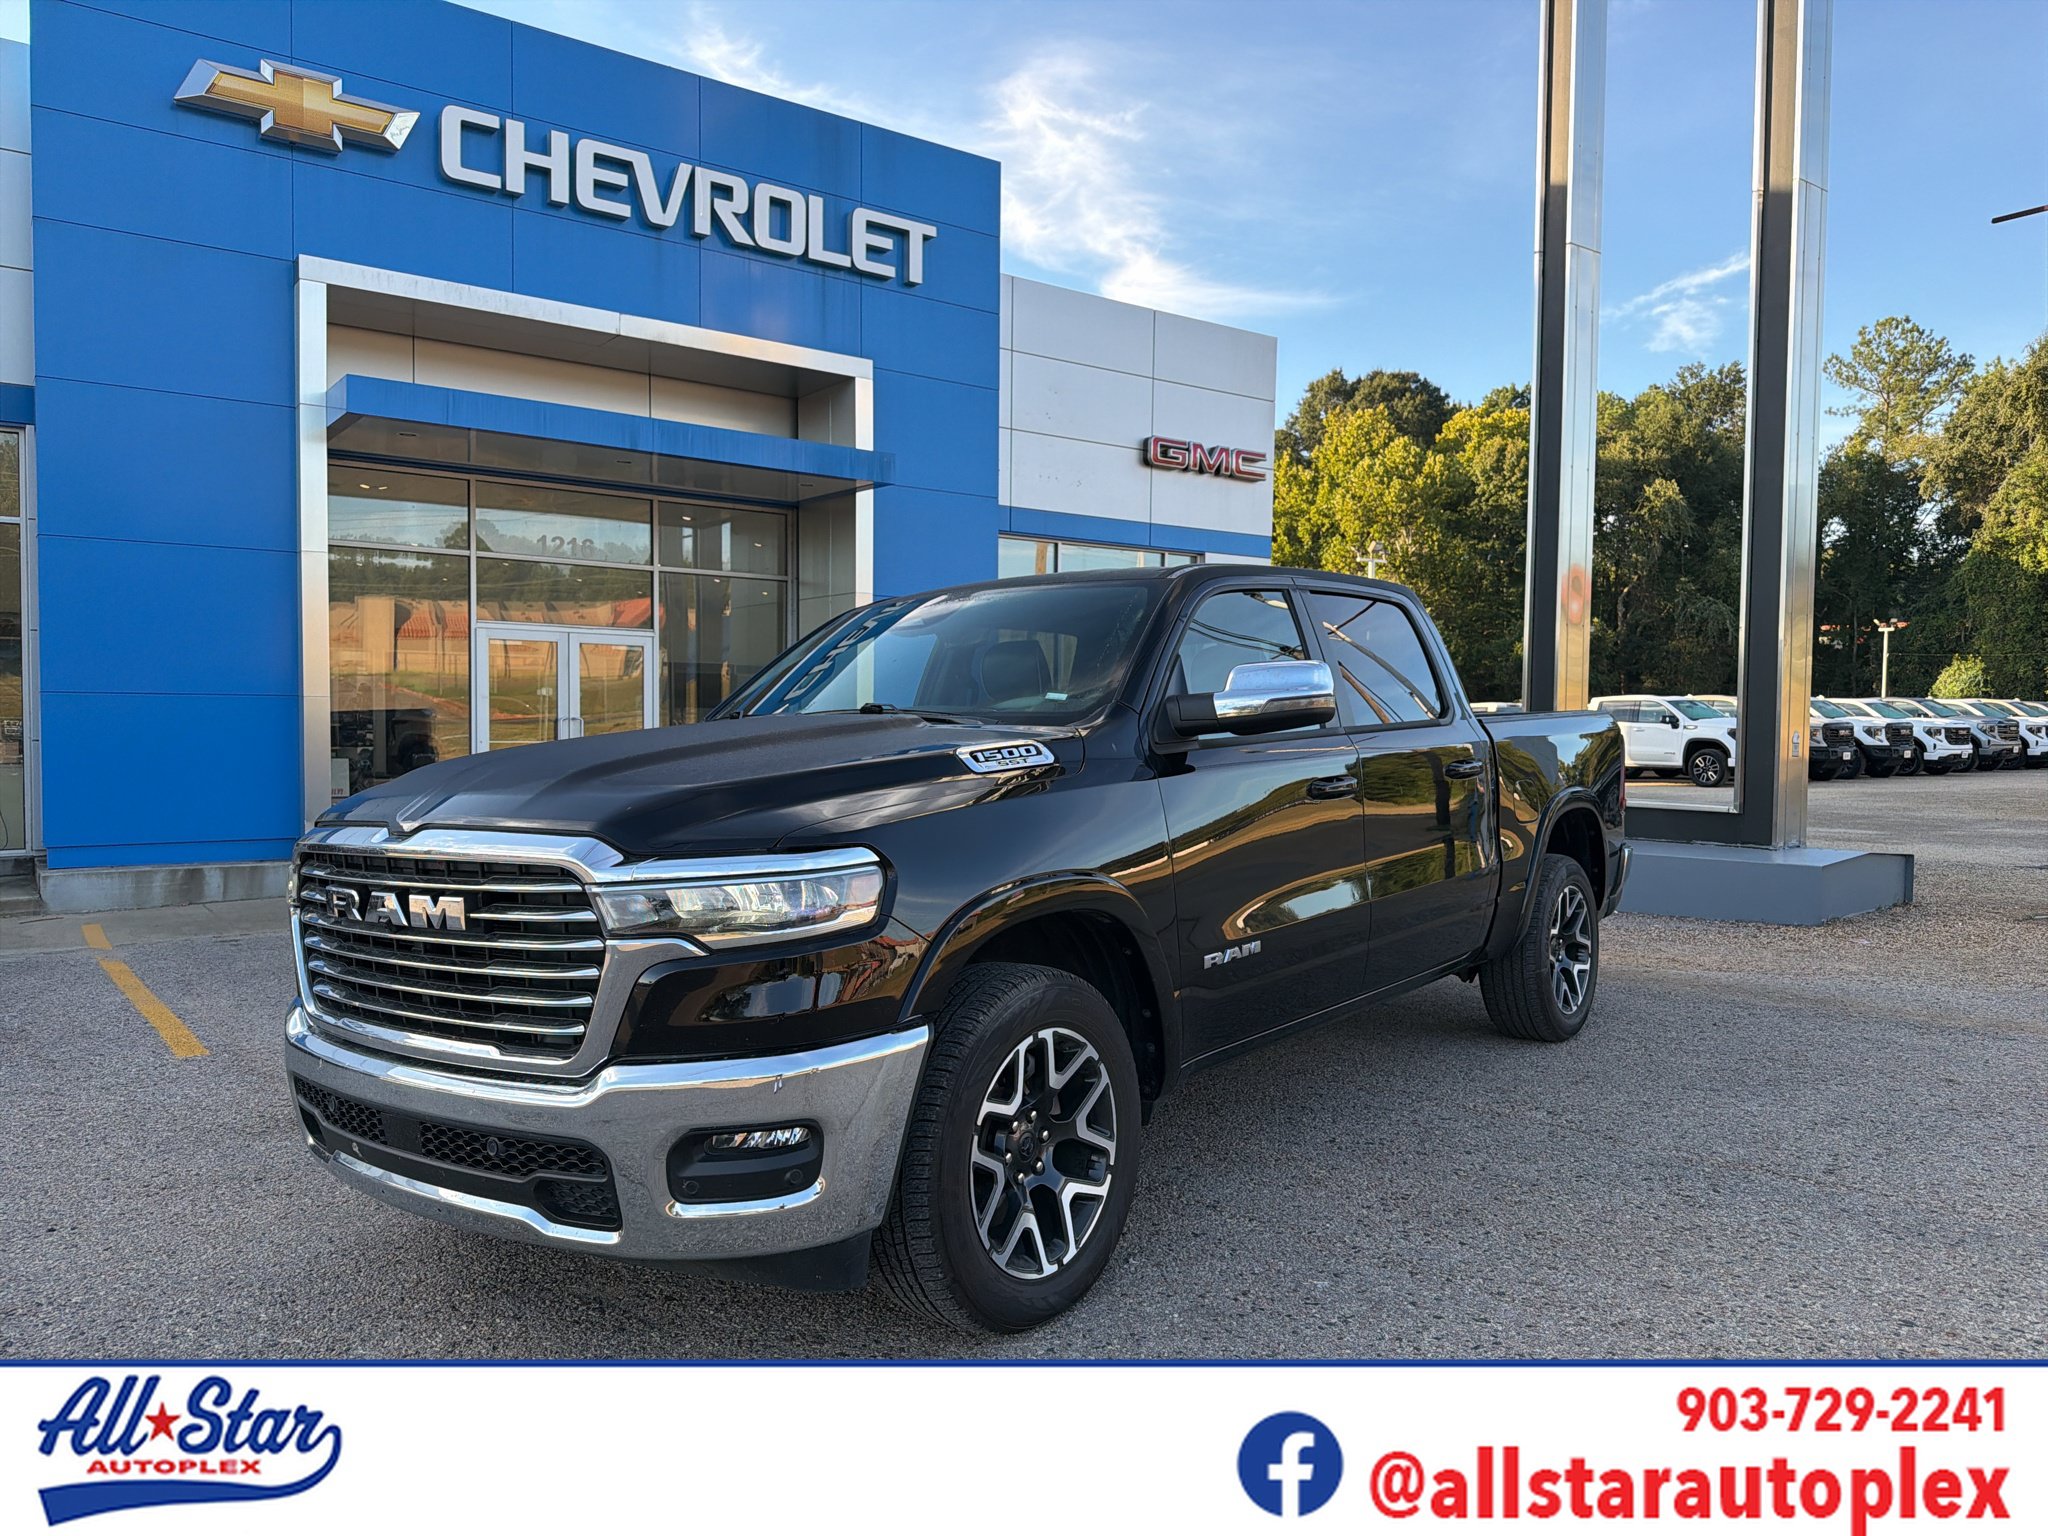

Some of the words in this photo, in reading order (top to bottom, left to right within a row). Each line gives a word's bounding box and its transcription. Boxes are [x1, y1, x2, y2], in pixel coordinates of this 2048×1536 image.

[439, 104, 938, 287] CHEVROLET
[1145, 434, 1267, 482] GMC
[536, 534, 595, 558] 1216
[973, 745, 1037, 762] 1500
[325, 884, 466, 931] RAM
[1203, 940, 1262, 970] RAM
